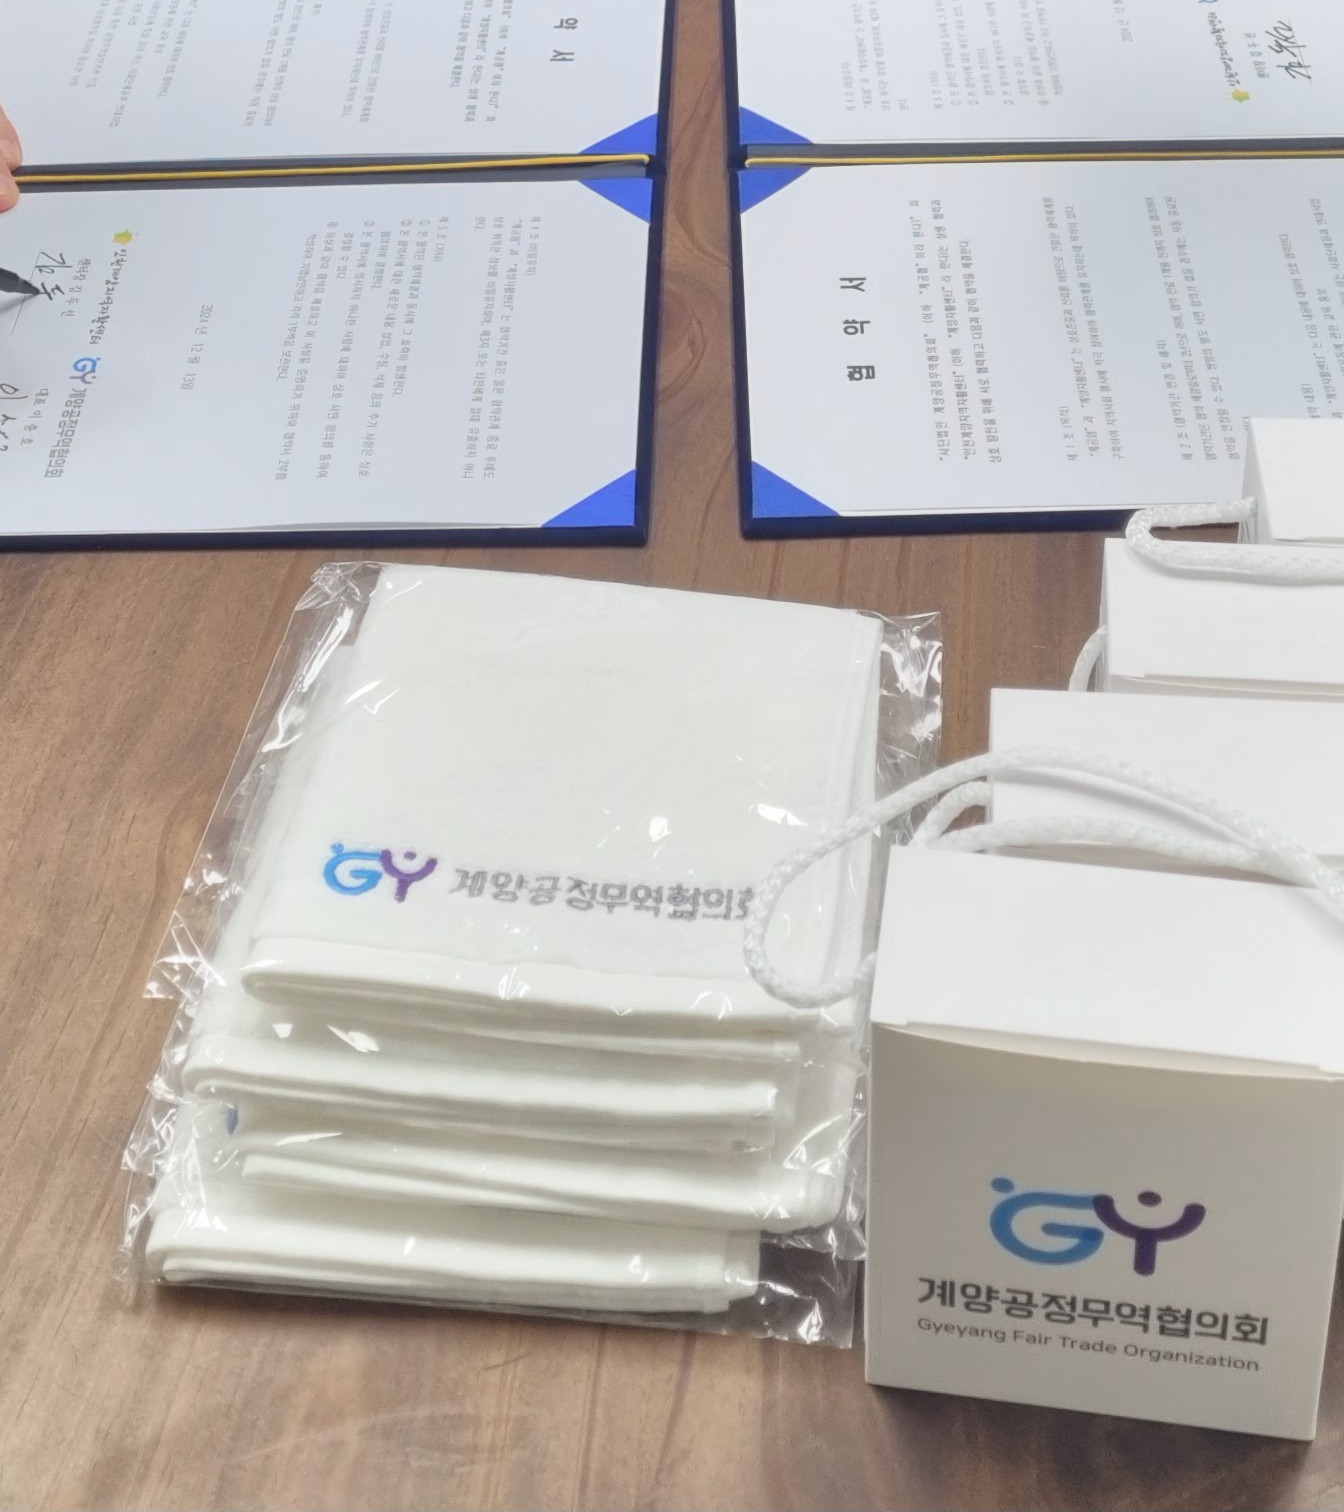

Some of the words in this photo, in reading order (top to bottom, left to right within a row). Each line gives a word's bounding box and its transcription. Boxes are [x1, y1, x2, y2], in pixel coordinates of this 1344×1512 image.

[552, 17, 579, 30] 약
[548, 48, 575, 62] 서
[838, 276, 868, 292] 서
[196, 304, 214, 322] 2024
[193, 326, 208, 334] 년
[842, 318, 872, 335] 약
[189, 343, 204, 352] 12
[66, 357, 102, 385] GY
[845, 364, 876, 381] 협
[44, 387, 84, 478] 계양공정무역협의회
[323, 842, 438, 903] GY
[989, 1176, 1207, 1276] GY
[917, 1276, 1270, 1346] 계양공정무역협의회
[917, 1317, 1007, 1344] Gyeyang
[1013, 1328, 1053, 1347] Fair
[1058, 1334, 1118, 1355] Trade
[1123, 1342, 1260, 1373] Organization
